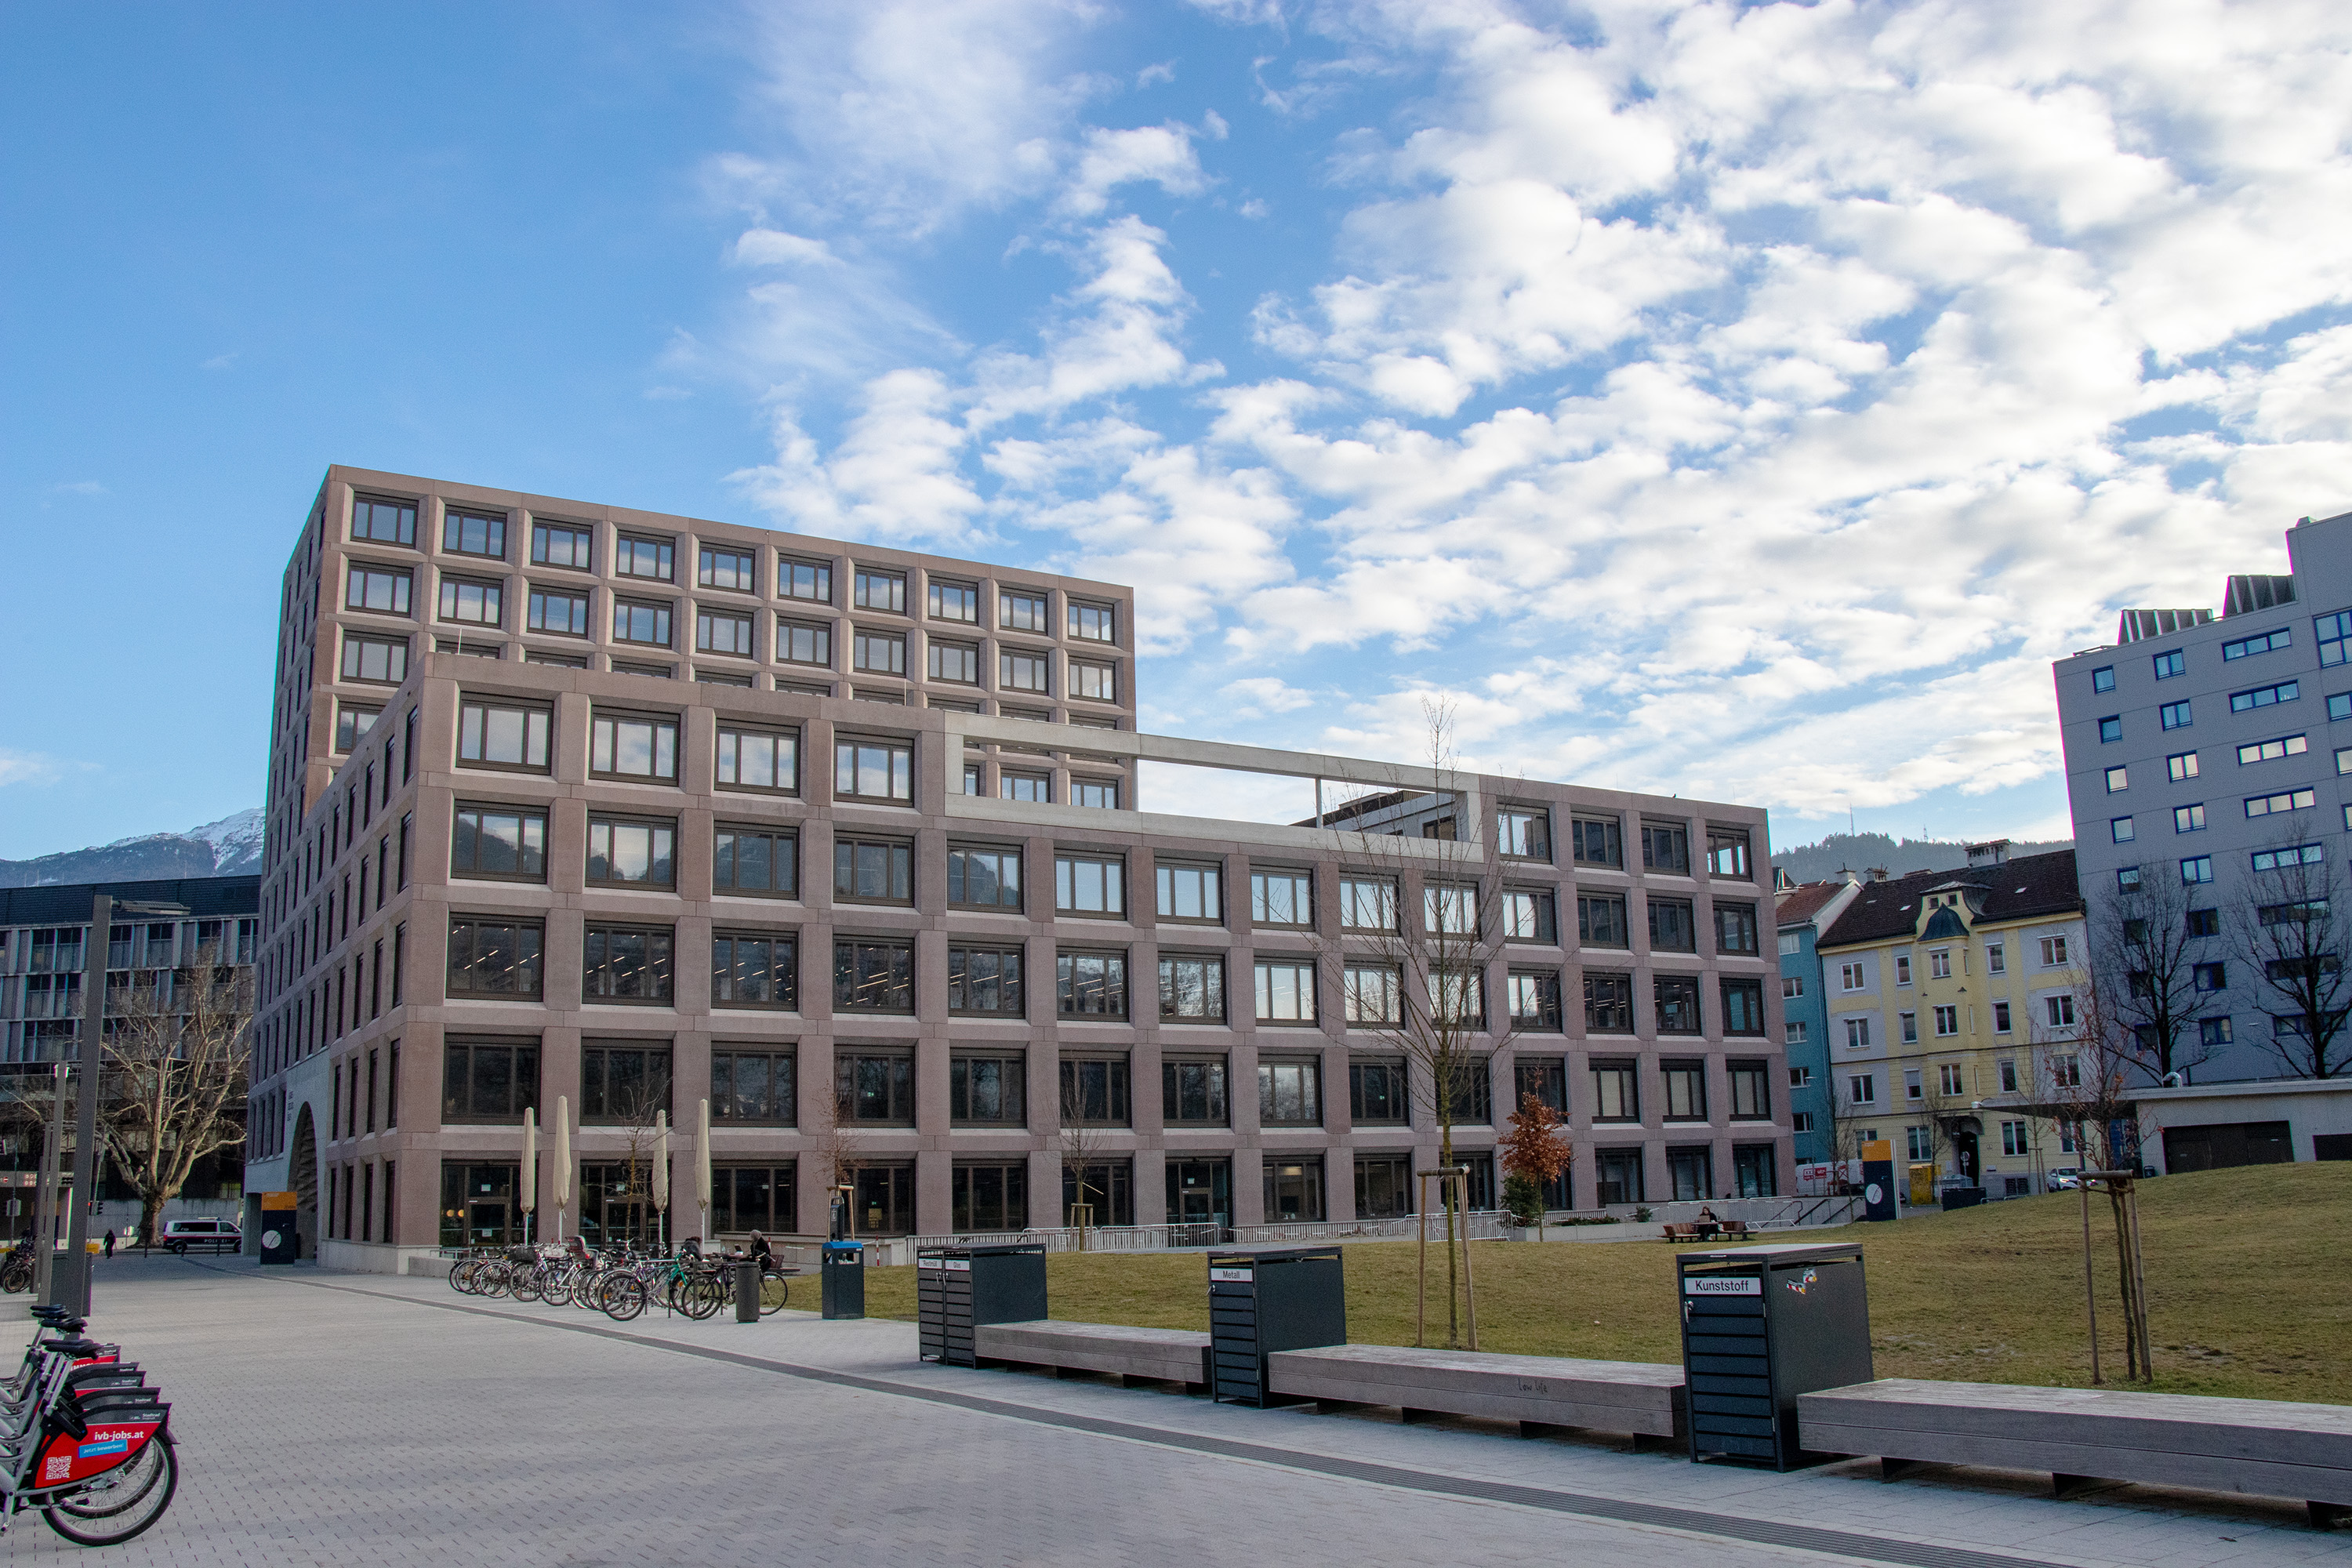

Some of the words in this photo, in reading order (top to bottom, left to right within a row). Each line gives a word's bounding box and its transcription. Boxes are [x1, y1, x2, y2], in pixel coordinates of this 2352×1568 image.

[1222, 1270, 1240, 1279] Metall
[1695, 1279, 1749, 1291] Kunststoff
[94, 1431, 144, 1442] ivb-jobs.at
